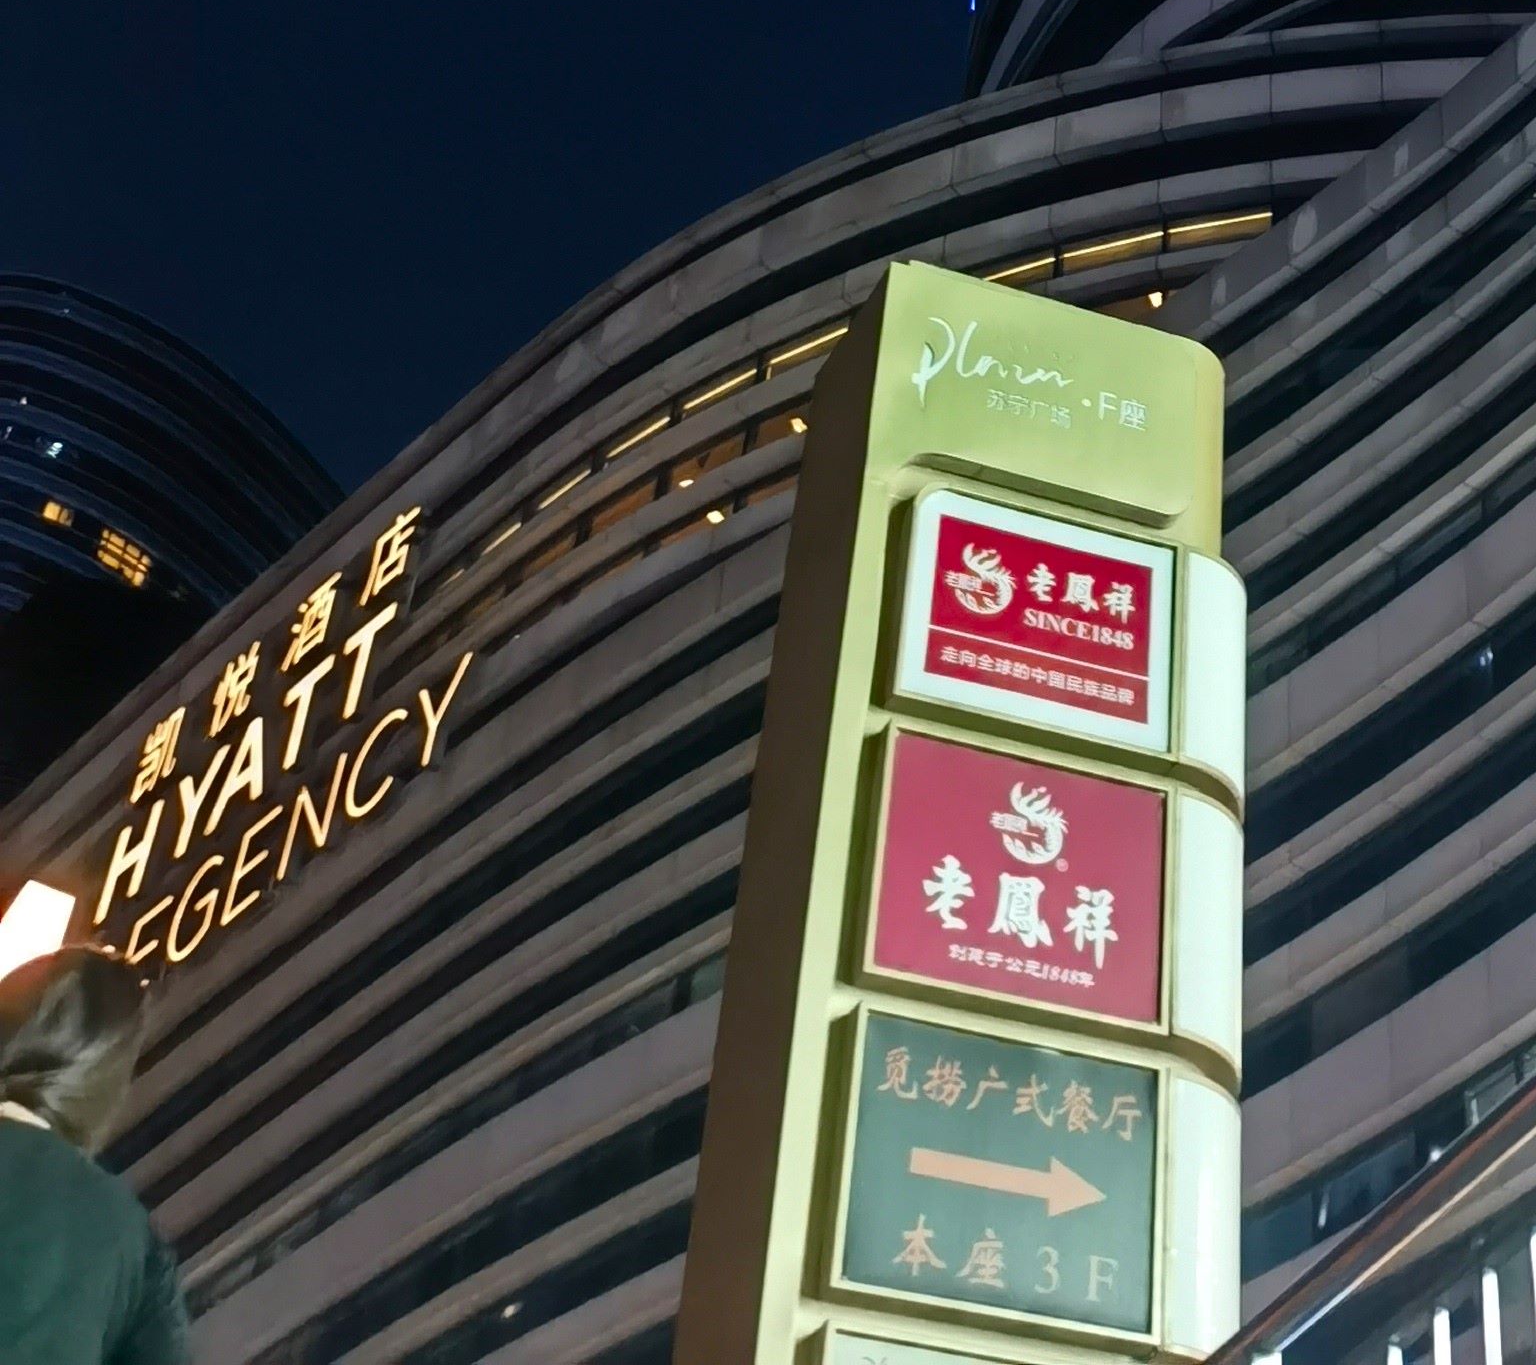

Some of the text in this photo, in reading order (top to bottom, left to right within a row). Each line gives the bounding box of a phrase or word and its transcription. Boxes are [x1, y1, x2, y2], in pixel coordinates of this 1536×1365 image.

[93, 602, 399, 926] HYATT
[129, 506, 422, 804] 凯悦酒店
[102, 652, 474, 965] EGENCY
[876, 1046, 1142, 1142] 觅捞广式餐厅
